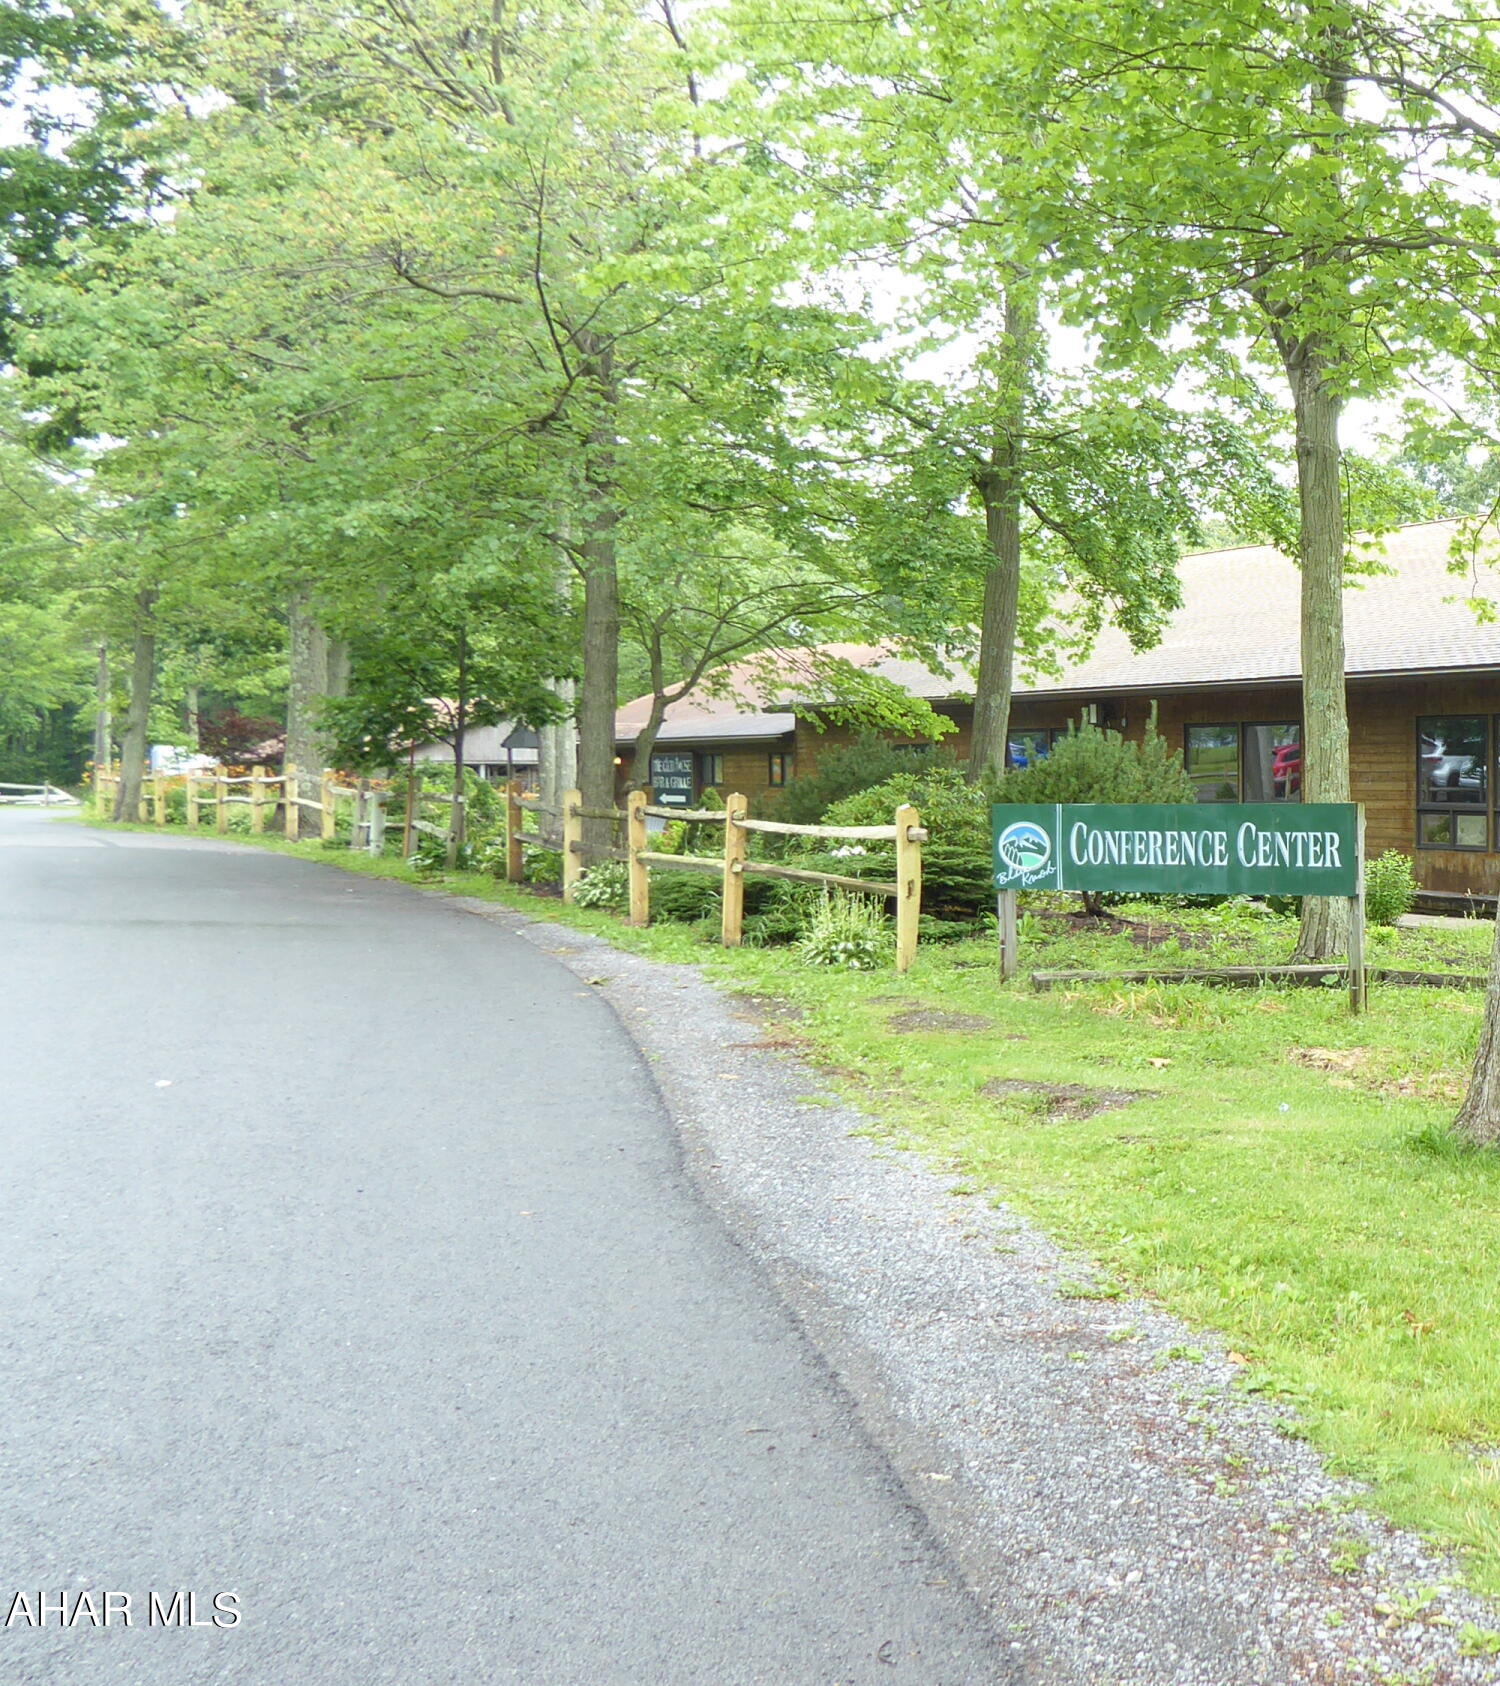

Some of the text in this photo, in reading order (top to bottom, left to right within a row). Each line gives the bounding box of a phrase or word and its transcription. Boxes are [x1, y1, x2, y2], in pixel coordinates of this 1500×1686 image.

[1070, 822, 1343, 868] CONFERENCE CENTER
[1022, 860, 1056, 887] Knob
